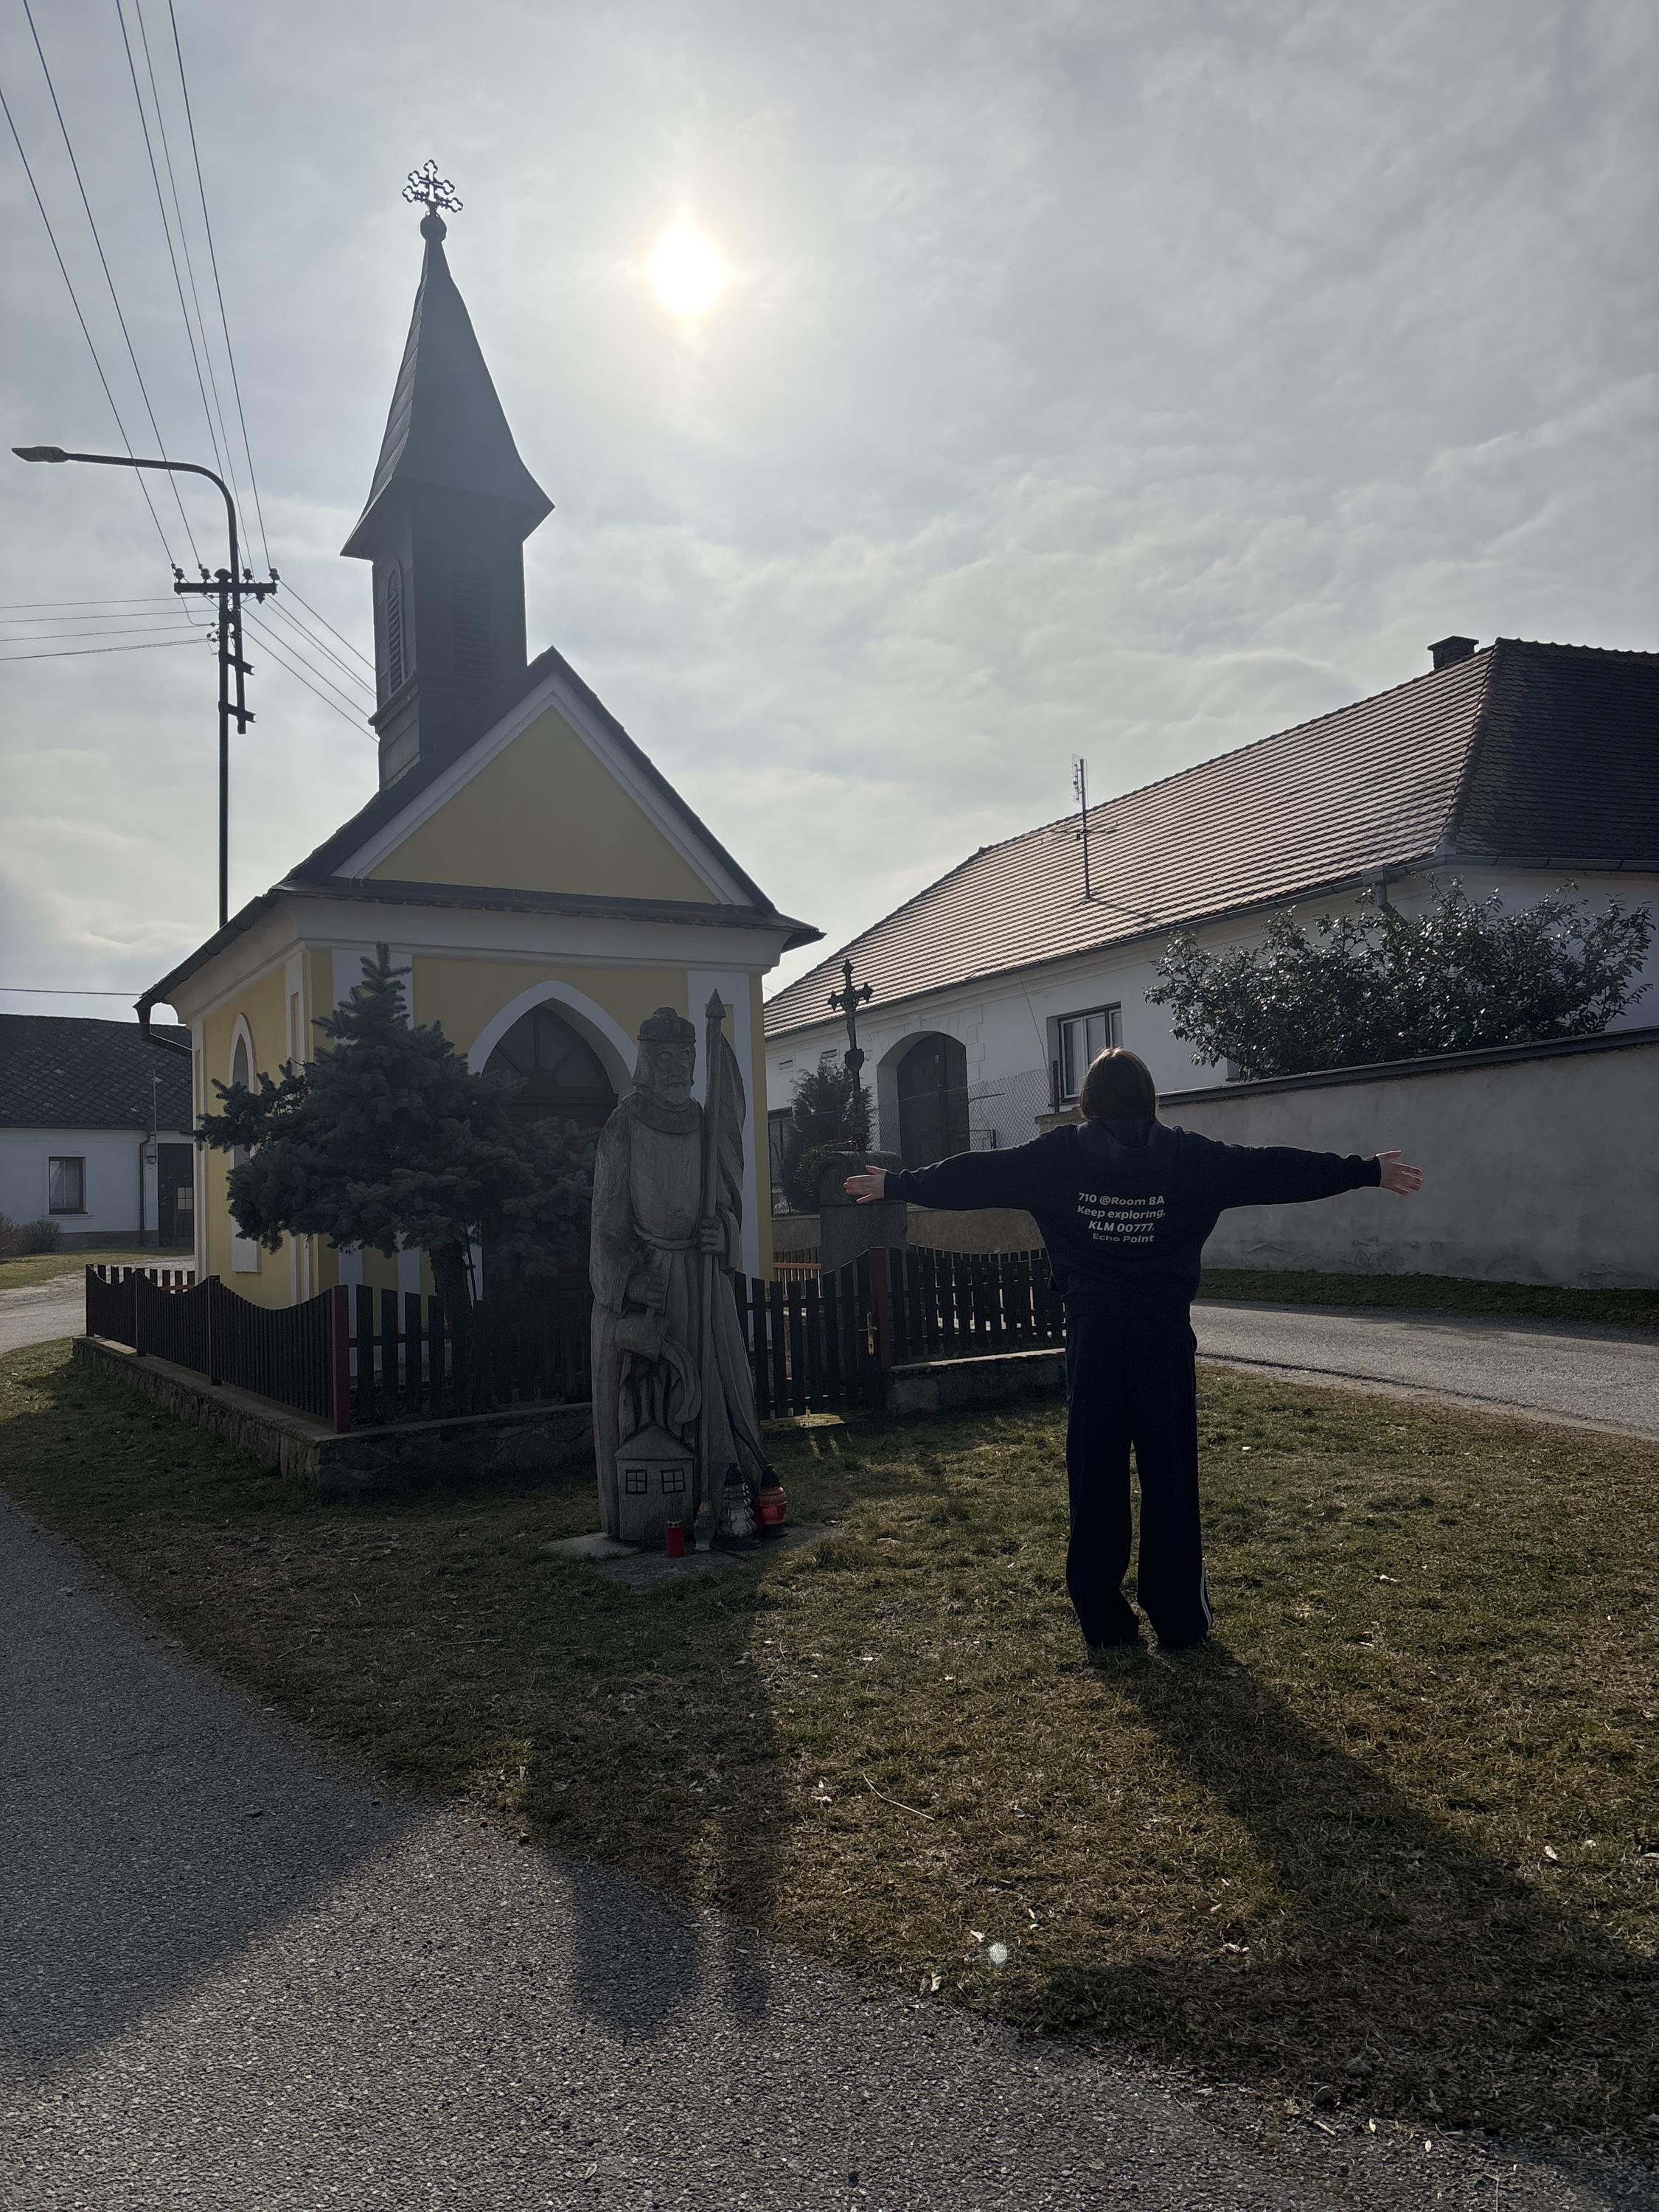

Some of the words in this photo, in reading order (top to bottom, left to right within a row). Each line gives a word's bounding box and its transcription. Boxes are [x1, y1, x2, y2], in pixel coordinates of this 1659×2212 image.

[1079, 1192, 1097, 1203] 710
[1099, 1195, 1146, 1206] @Room
[1148, 1195, 1165, 1206] 8A
[1077, 1205, 1105, 1219] Keep
[1088, 1221, 1115, 1232] KLM
[1123, 1234, 1155, 1243] Point
